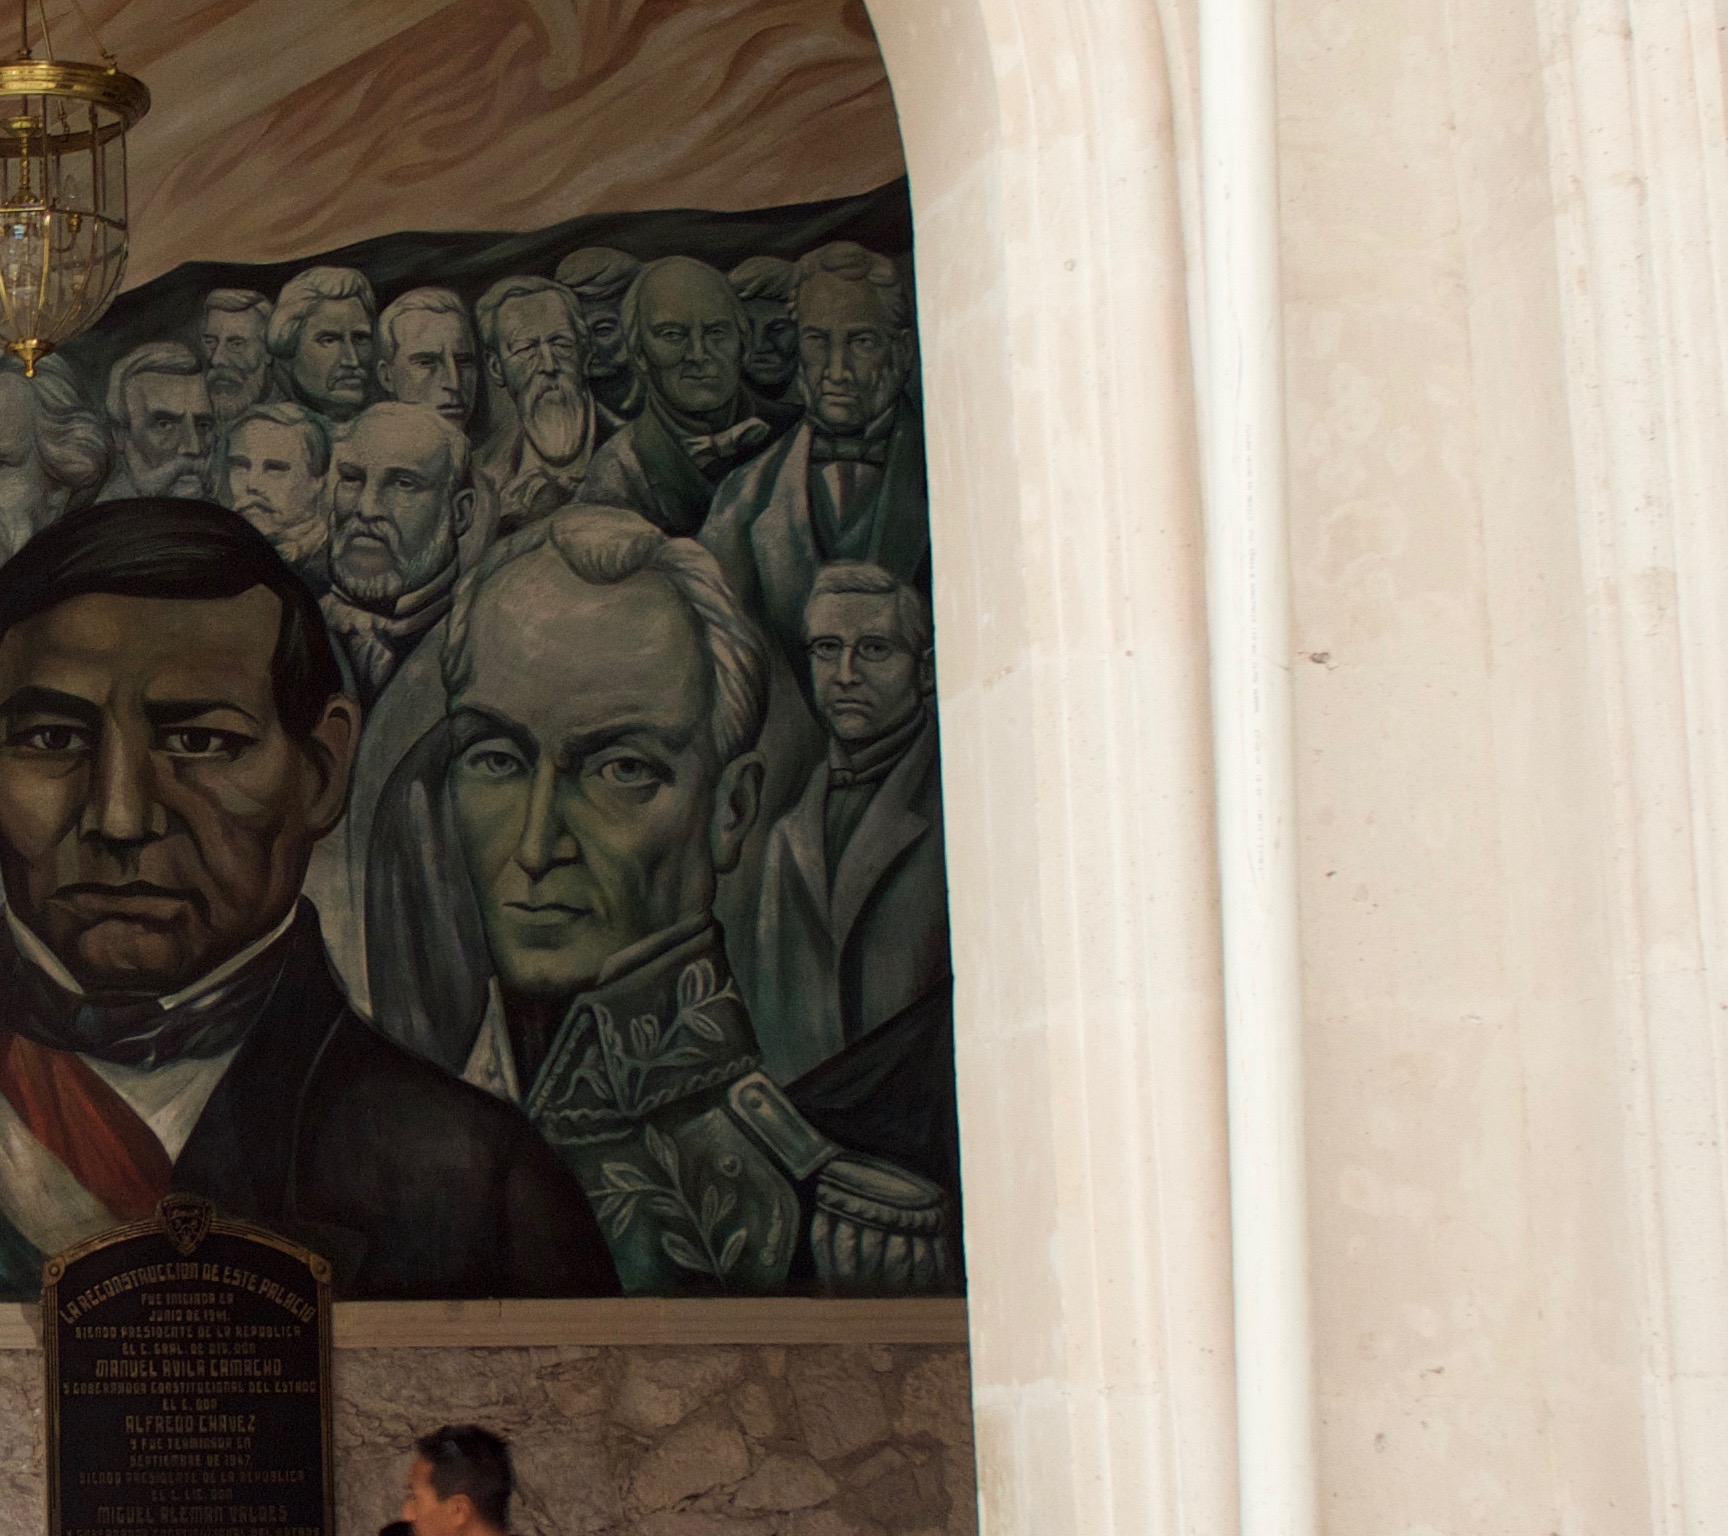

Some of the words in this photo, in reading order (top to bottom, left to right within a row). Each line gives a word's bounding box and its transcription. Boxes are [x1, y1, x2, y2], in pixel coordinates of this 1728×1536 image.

[59, 1300, 82, 1324] LA
[78, 1262, 199, 1313] RECONSTRUCCION
[202, 1263, 220, 1281] DE
[222, 1265, 258, 1292] ESTE
[258, 1276, 318, 1323] PALACIO
[141, 1292, 163, 1306] FUE
[166, 1292, 215, 1306] INICIADA
[149, 1309, 182, 1322] JUNIO
[186, 1309, 200, 1322] DE
[75, 1326, 117, 1339] SIENDO
[120, 1326, 193, 1339] PRESIDENTE
[197, 1326, 212, 1339] DE
[217, 1326, 231, 1339] LA
[235, 1325, 301, 1338] REPUBLICA
[122, 1342, 136, 1355] EL
[190, 1342, 204, 1355] DE
[95, 1359, 157, 1378] MANUEL
[162, 1359, 205, 1378] AVILA
[210, 1359, 282, 1378] CAMACHO
[73, 1381, 147, 1395] GOBERNADOR
[150, 1381, 245, 1395] CONSTITUCIONAL
[248, 1381, 269, 1395] DEL
[274, 1381, 317, 1395] ESTADO
[125, 1414, 194, 1434] ALFREDO
[199, 1414, 256, 1434] CHAVEZ
[141, 1437, 163, 1451] FUE
[167, 1437, 232, 1451] TERMINADA
[129, 1454, 201, 1468] SEPTIEMBRE
[206, 1454, 221, 1468] DE
[97, 1505, 154, 1524] MIGUEL
[160, 1505, 223, 1524] ALEMAN
[229, 1505, 288, 1524] VALDES
